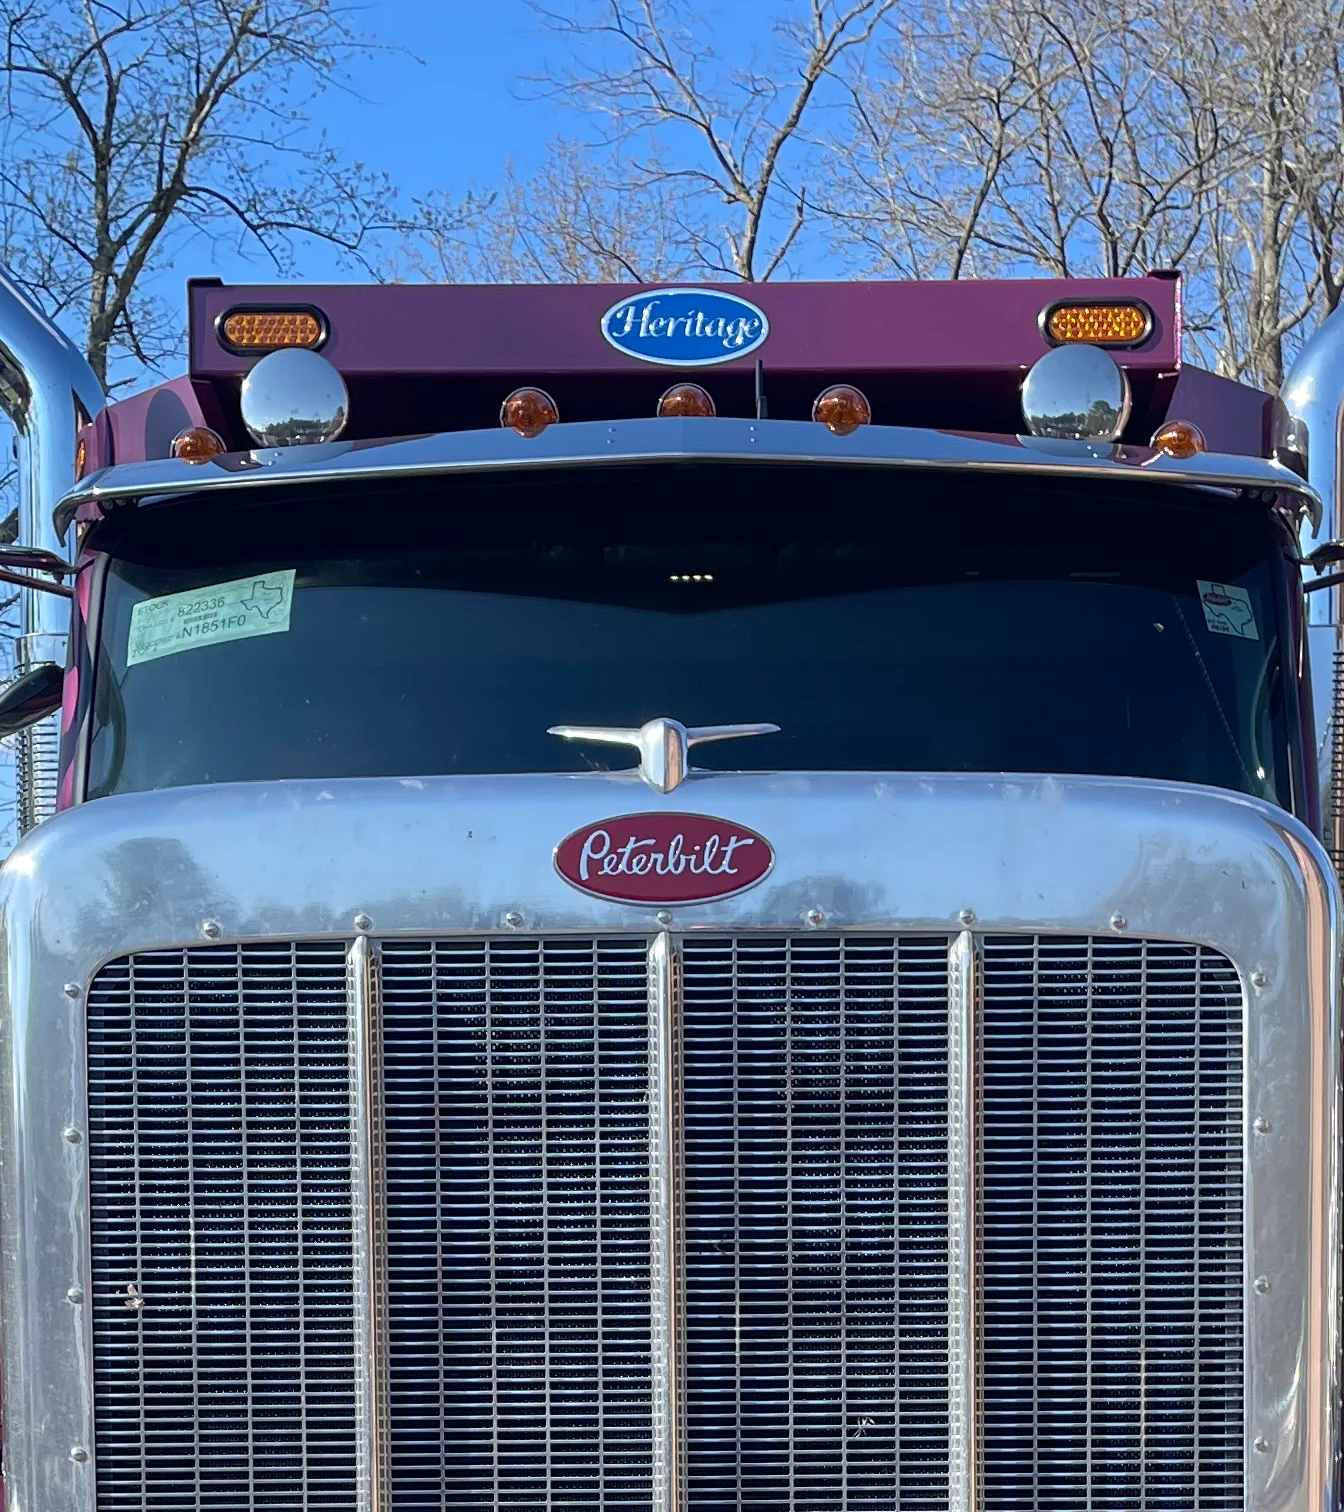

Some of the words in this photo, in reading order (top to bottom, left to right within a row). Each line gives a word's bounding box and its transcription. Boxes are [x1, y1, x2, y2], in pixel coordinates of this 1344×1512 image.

[611, 300, 760, 349] Heritage
[137, 599, 170, 616] STOCK
[177, 596, 225, 617] 822336
[181, 614, 246, 639] N1851F0
[578, 829, 755, 881] Peterbilt
